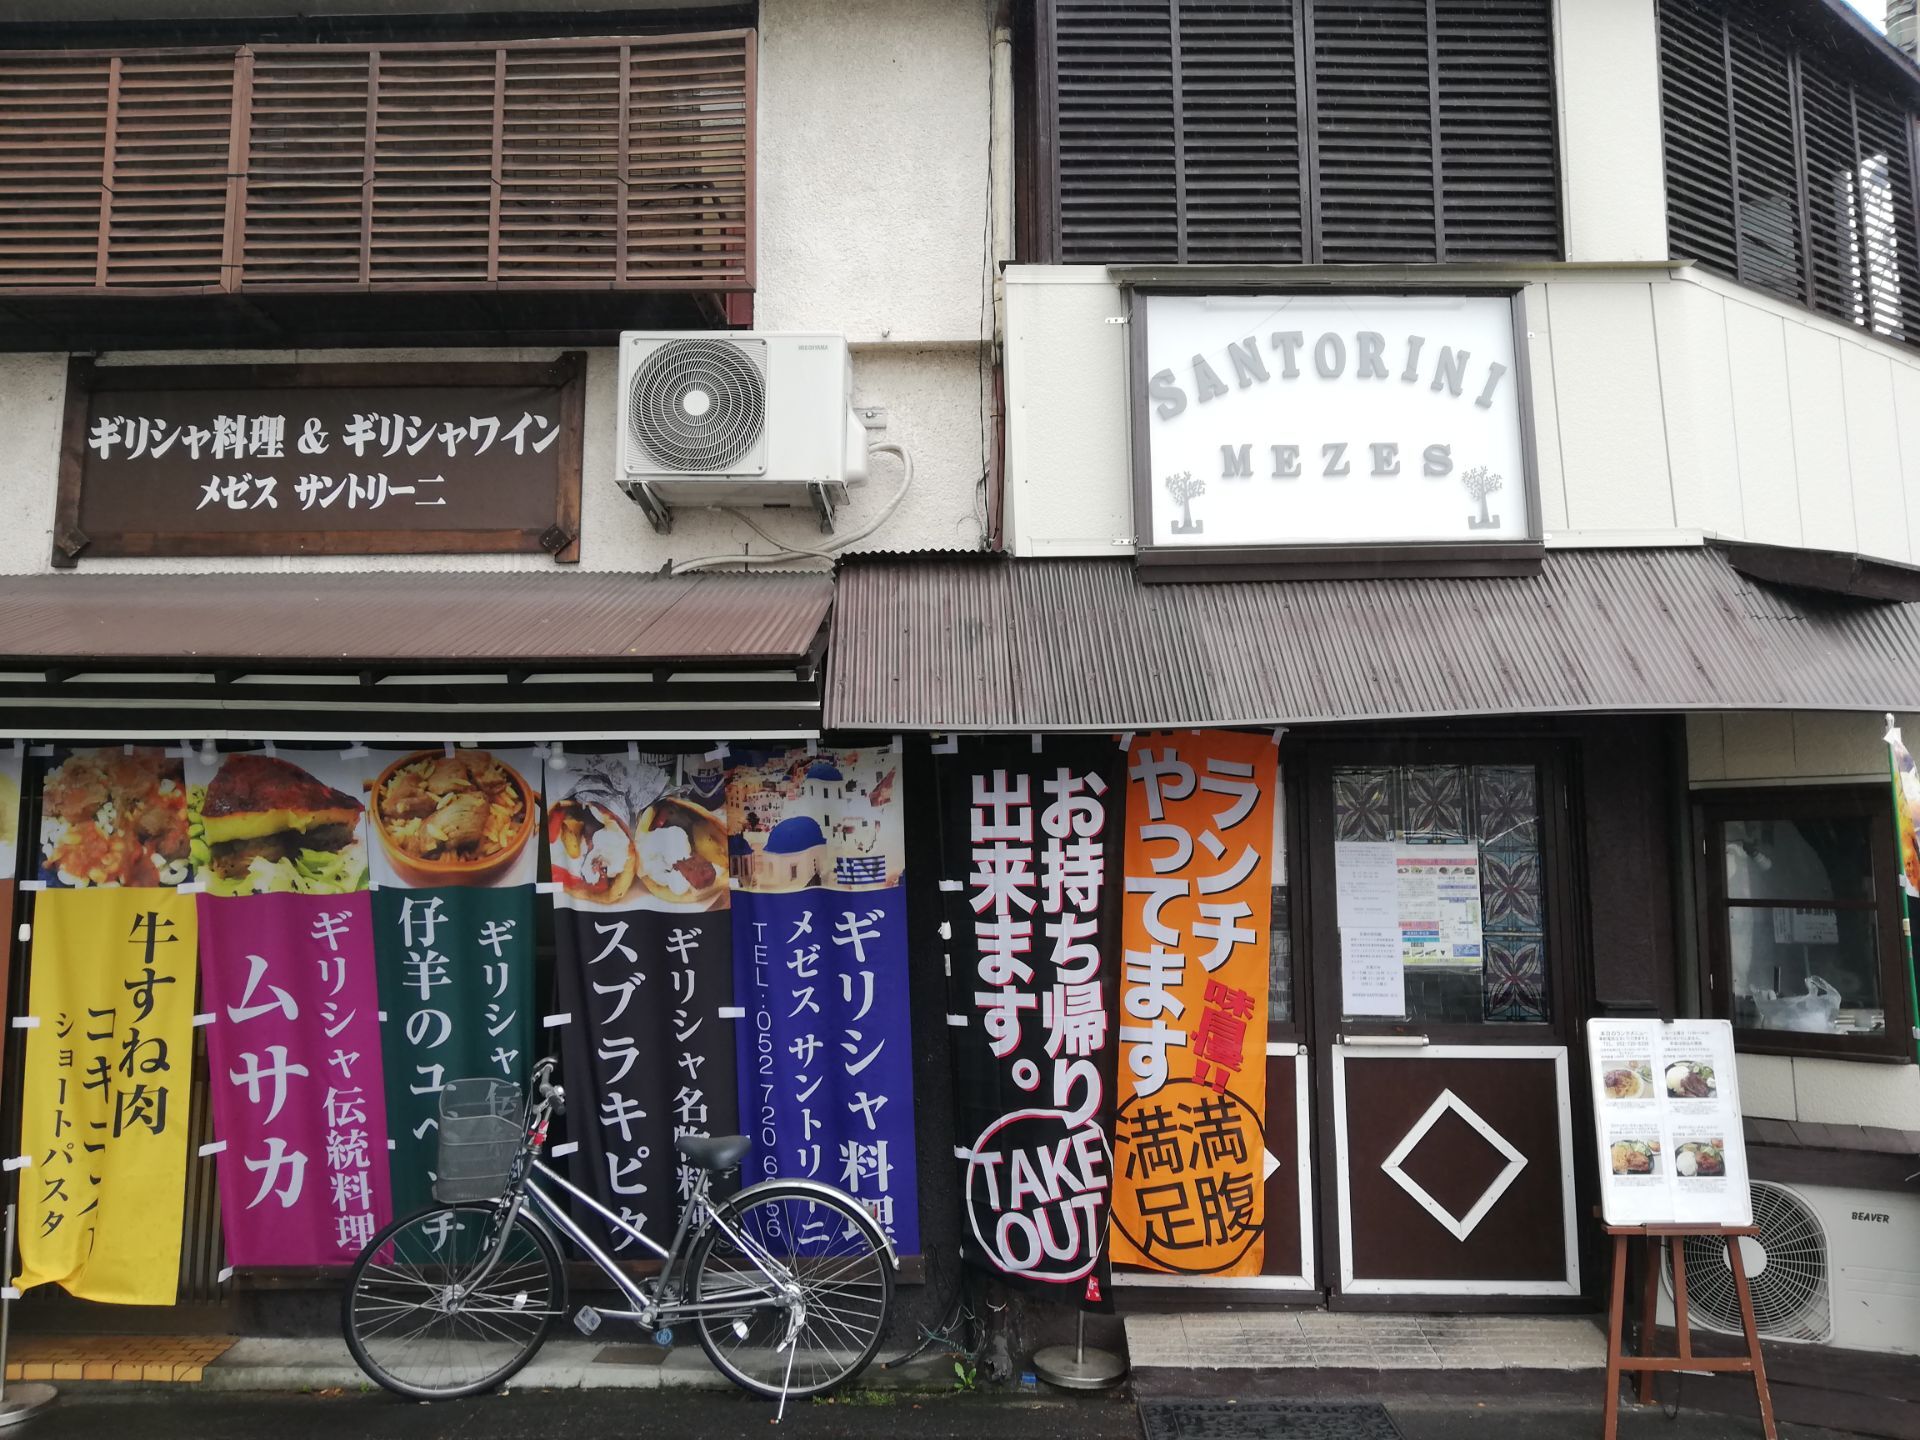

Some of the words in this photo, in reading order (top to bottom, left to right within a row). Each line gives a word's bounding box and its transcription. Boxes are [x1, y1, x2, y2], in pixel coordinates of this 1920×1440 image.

[88, 414, 285, 460] ギリシャ料理
[297, 417, 330, 455] &
[342, 411, 560, 458] ギリシャワイン
[1149, 331, 1507, 421] SANTORINI
[195, 473, 278, 510] メゼス
[294, 473, 446, 510] サントリーニ
[1220, 441, 1454, 478] MEZES
[969, 769, 1041, 1092] 出来ます。
[1119, 747, 1198, 1100] やってます
[1191, 758, 1261, 973] ランチ
[113, 911, 179, 1138] 牛すね肉
[786, 910, 822, 1018] メゼス
[1041, 767, 1108, 1130] お持ち帰り
[39, 1011, 77, 1239] ショートパスタ
[227, 954, 309, 1210] ムサカ
[311, 910, 376, 1252] ギリシャ伝統料理
[832, 909, 895, 1245] ギリシャ料理
[970, 1132, 1108, 1211] TAKE
[996, 1192, 1104, 1271] OUT
[1115, 1105, 1208, 1254] 満足
[1175, 1096, 1265, 1249] 満腹
[1851, 1211, 1890, 1224] BEAVER
